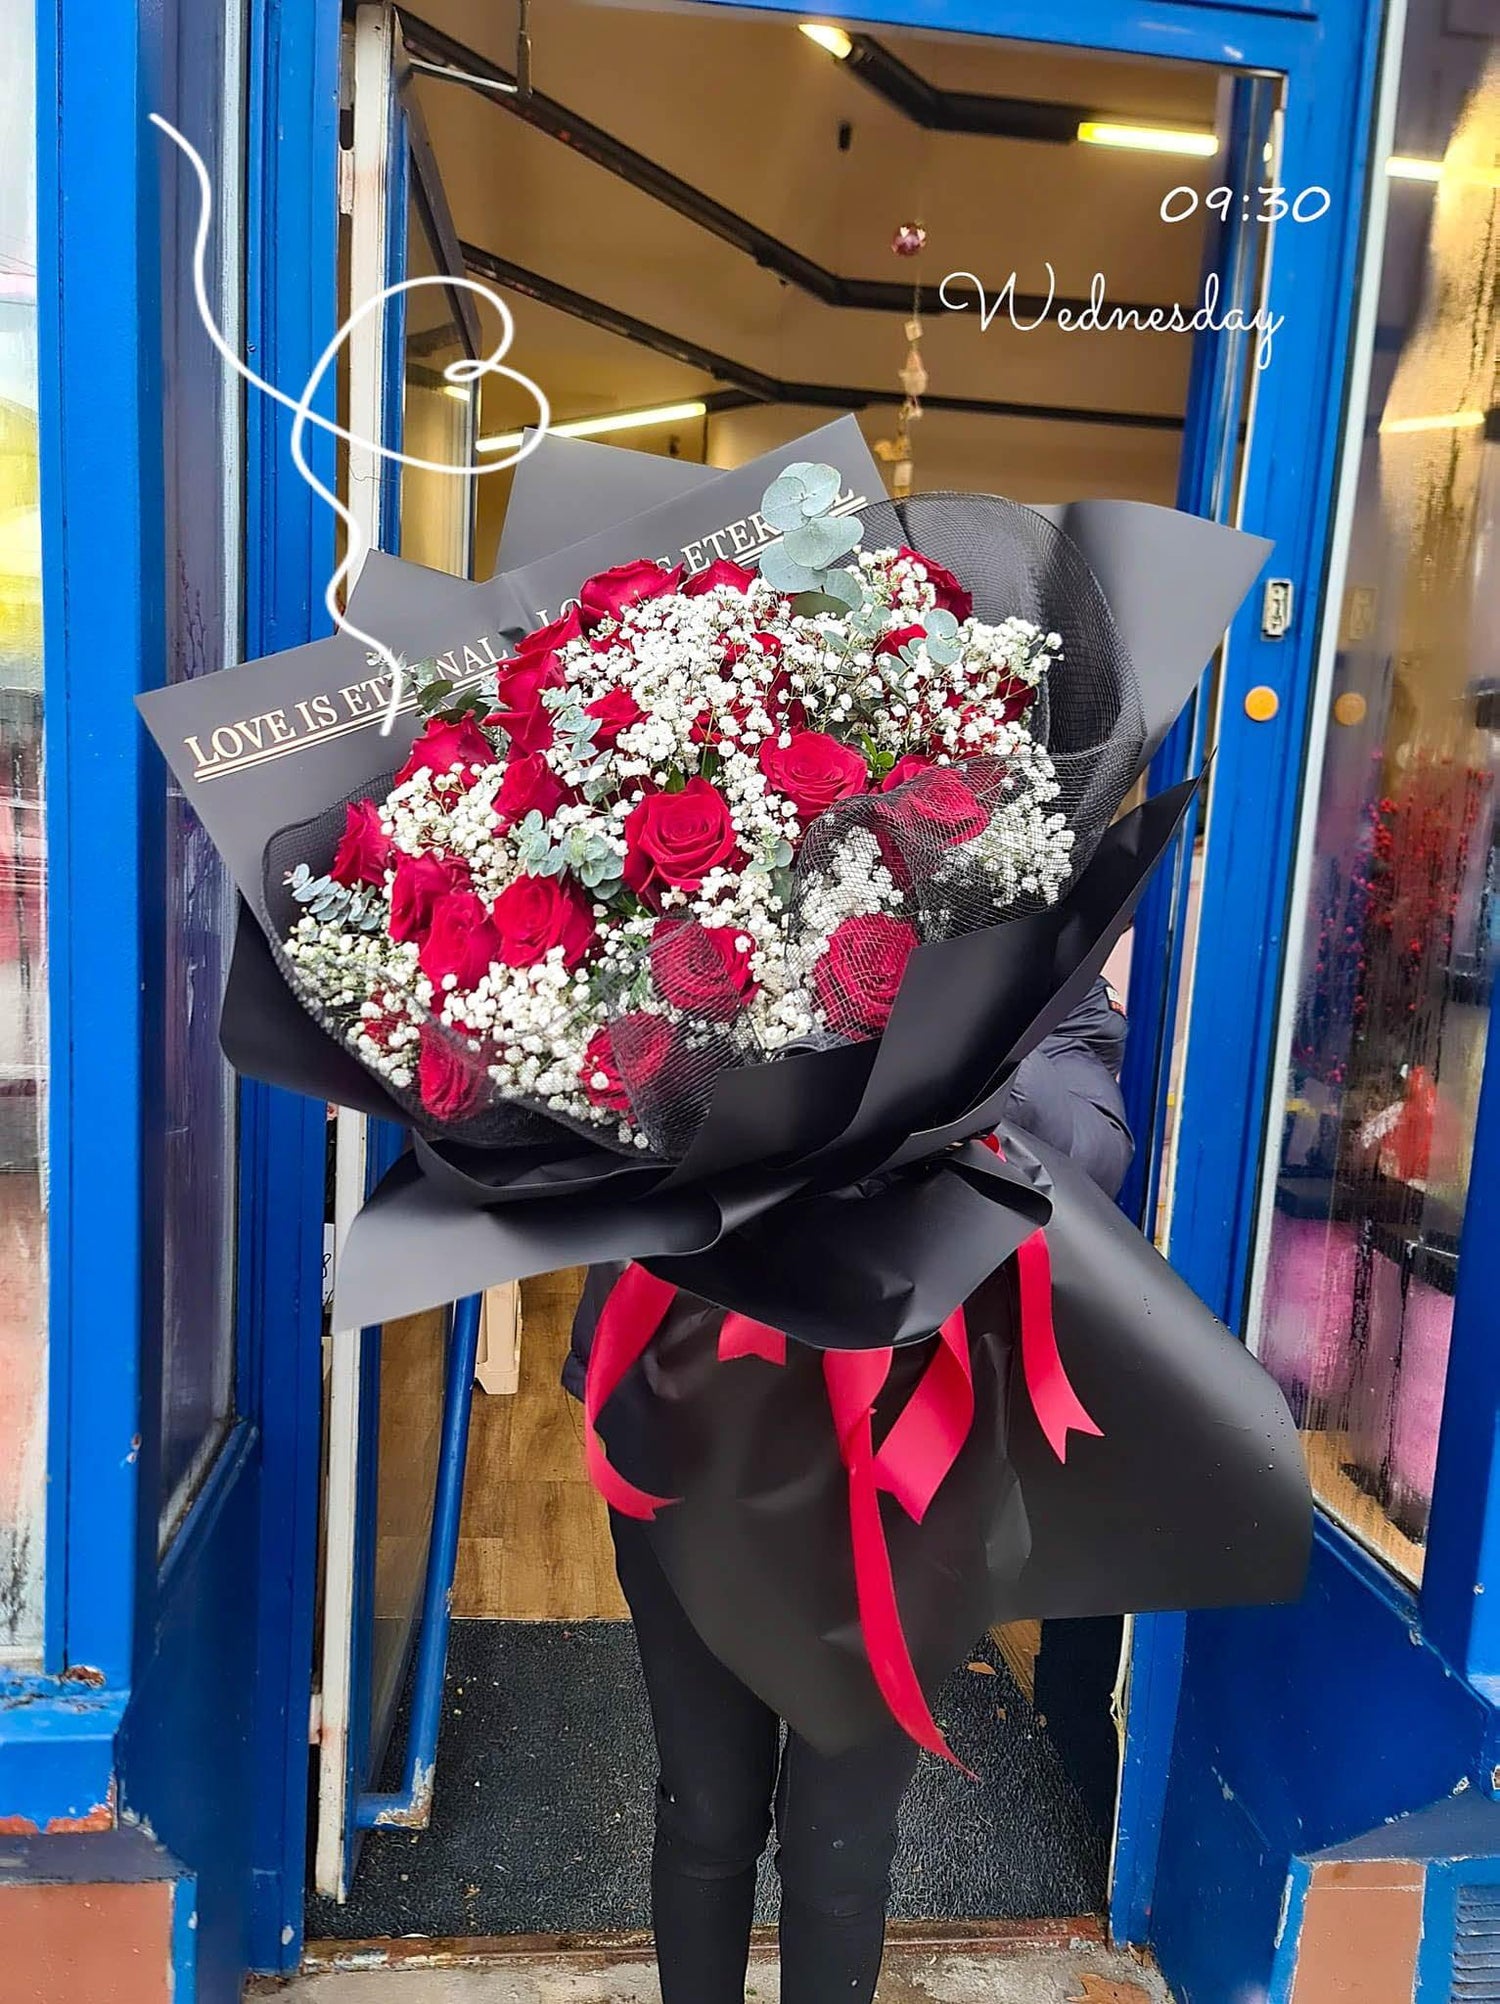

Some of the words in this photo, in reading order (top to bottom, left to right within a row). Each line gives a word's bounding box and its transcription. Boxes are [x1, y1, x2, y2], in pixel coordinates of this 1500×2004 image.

[184, 709, 297, 768] LOVE
[294, 694, 338, 733] IS
[337, 636, 509, 717] ETNAL
[680, 489, 855, 576] ETER
